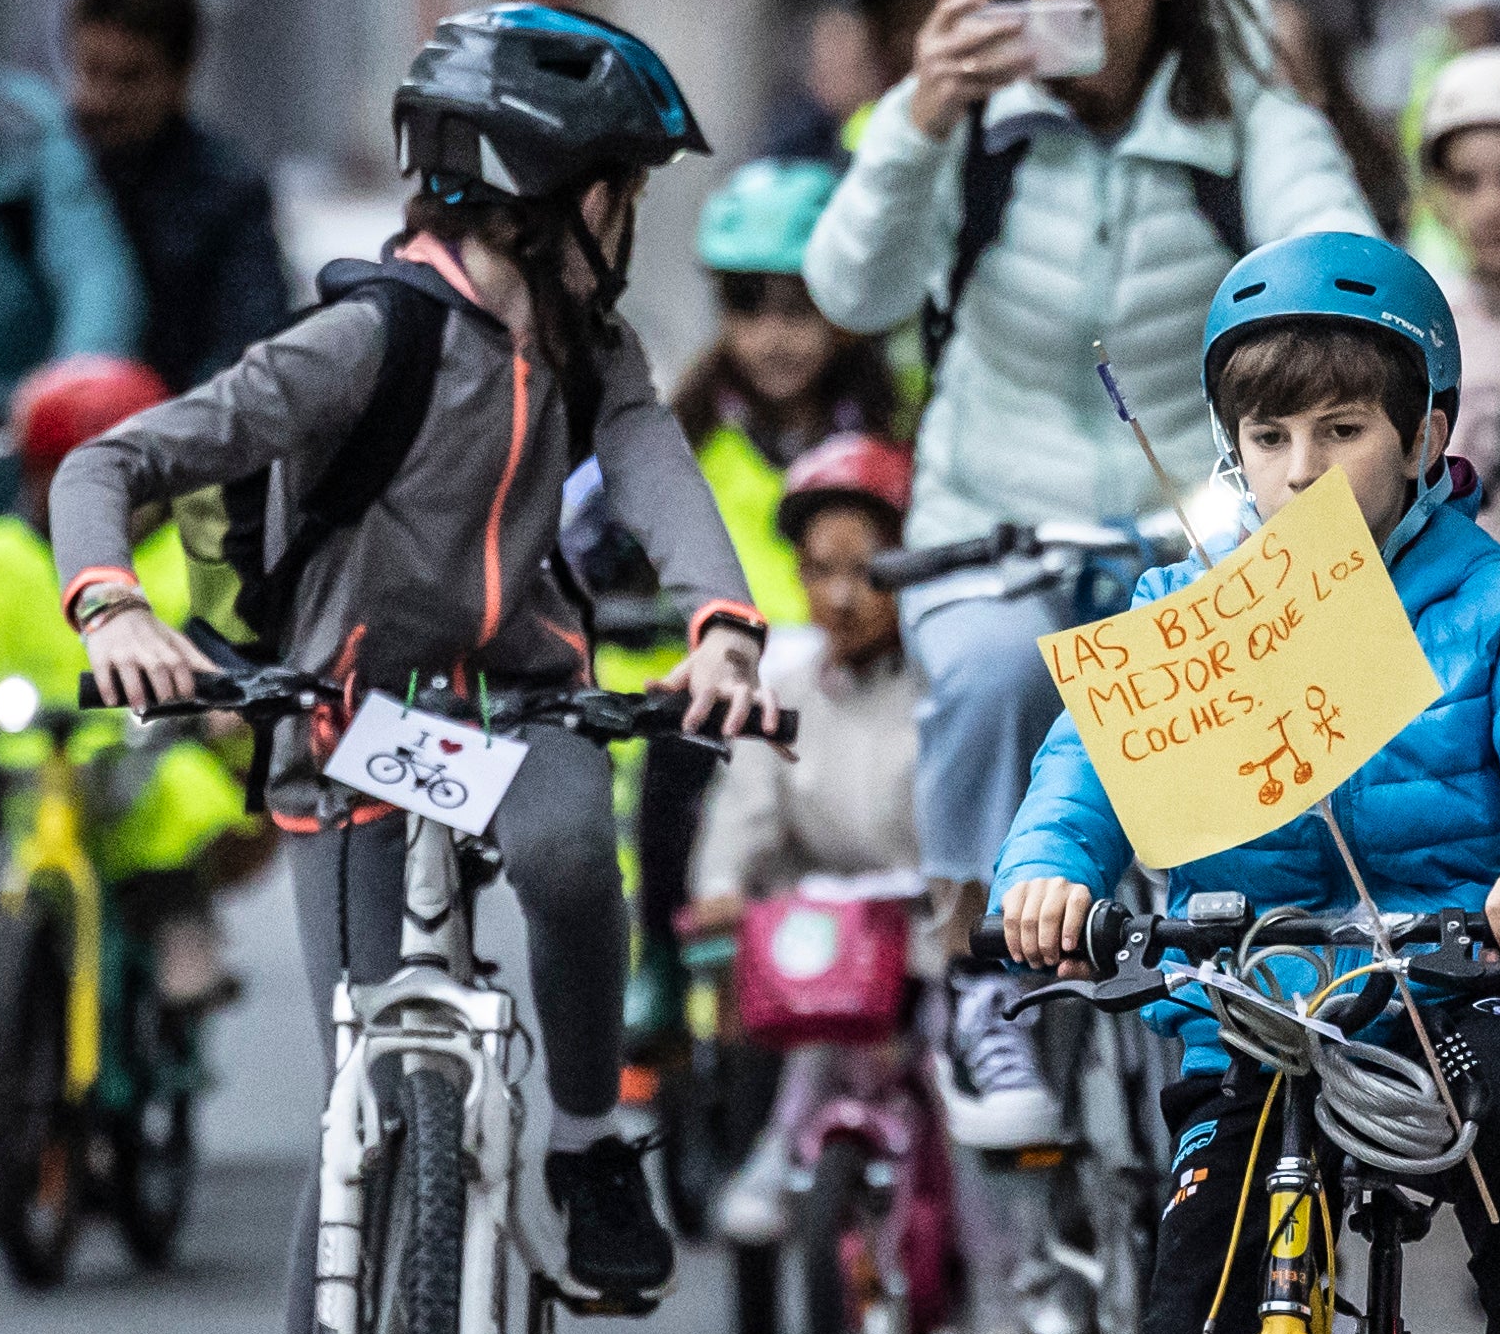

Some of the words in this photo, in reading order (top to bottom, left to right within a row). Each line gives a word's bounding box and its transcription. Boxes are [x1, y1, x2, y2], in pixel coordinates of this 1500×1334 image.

[1051, 623, 1129, 685] LAS
[1153, 531, 1293, 650] BICIS
[1088, 640, 1235, 726] MEJOR
[1248, 598, 1304, 662] QUE
[412, 730, 430, 749] I
[1121, 689, 1263, 762] COCHES.
